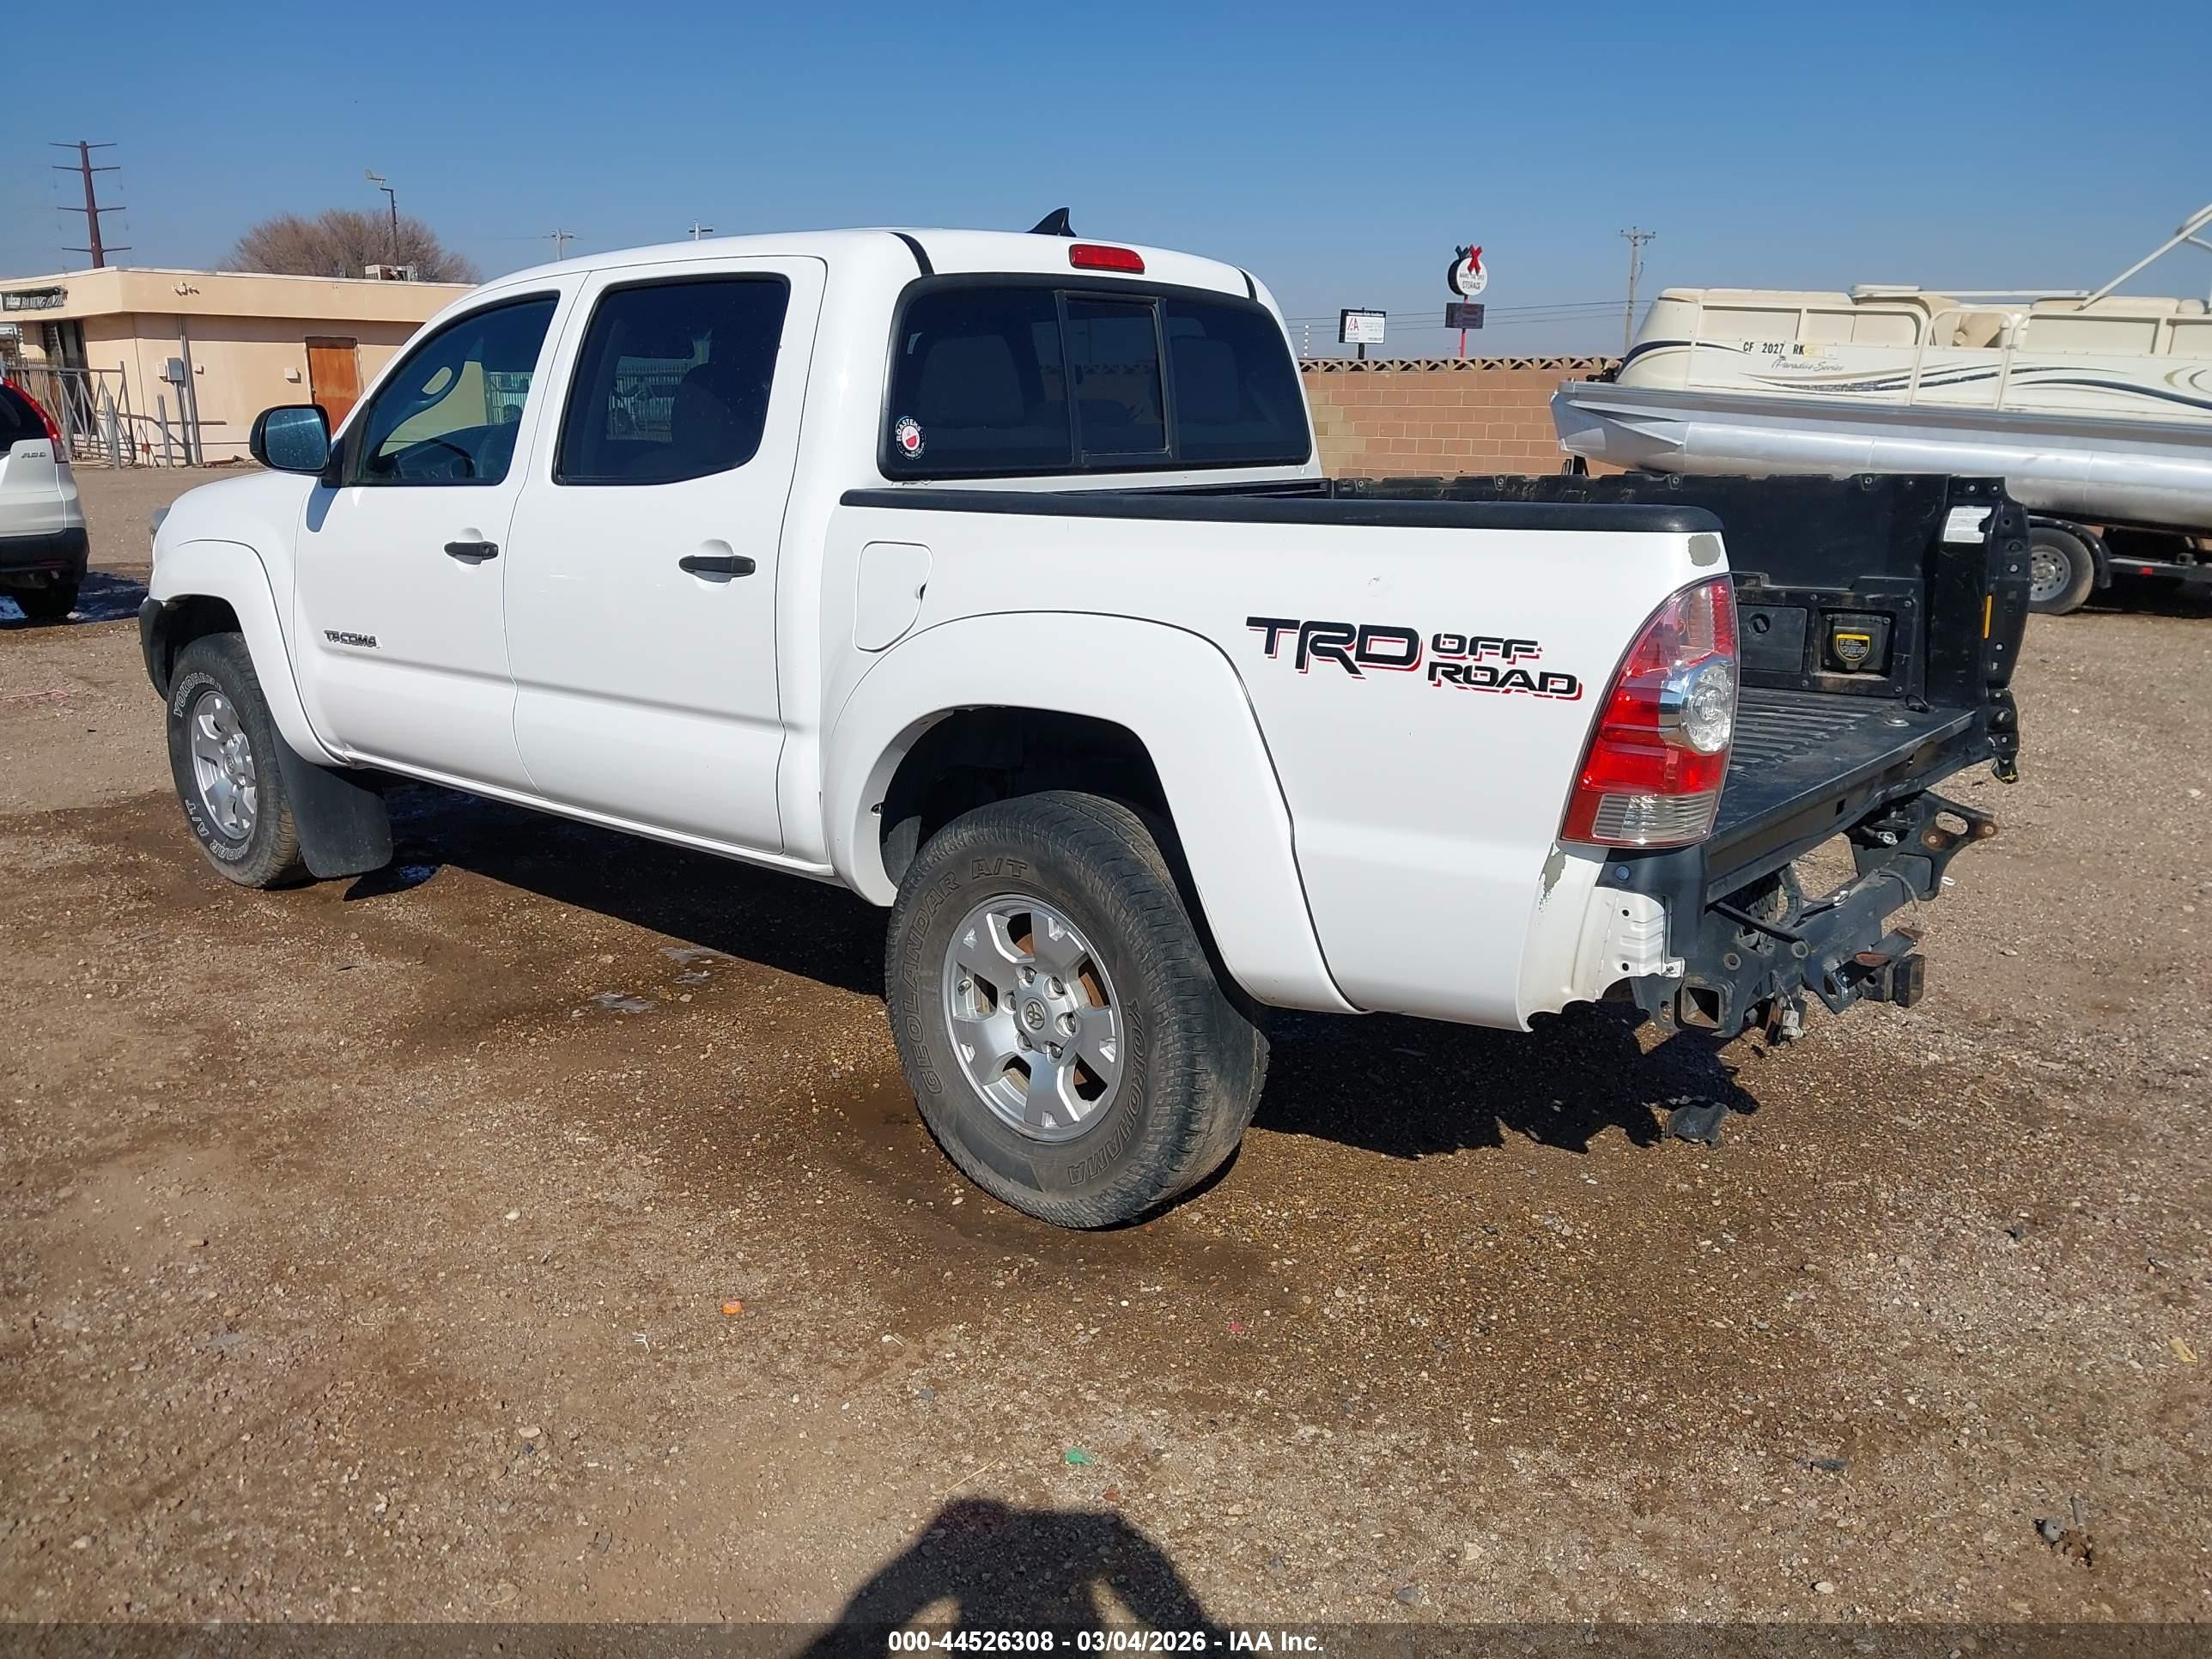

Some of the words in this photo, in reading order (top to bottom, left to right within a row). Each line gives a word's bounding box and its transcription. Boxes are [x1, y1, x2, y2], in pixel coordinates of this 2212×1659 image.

[1743, 342, 1754, 352] CF
[1761, 343, 1785, 354] 2027
[1792, 344, 1805, 355] RK
[1814, 361, 1845, 371] Series
[324, 629, 378, 647] TACOMA
[1245, 616, 1424, 680] TRD
[1431, 632, 1542, 665] OFF
[1427, 660, 1583, 701] ROAD
[902, 871, 962, 1095] GEOLANDAR
[971, 858, 1028, 879] A/T
[1067, 999, 1146, 1187] YOKOHAMA
